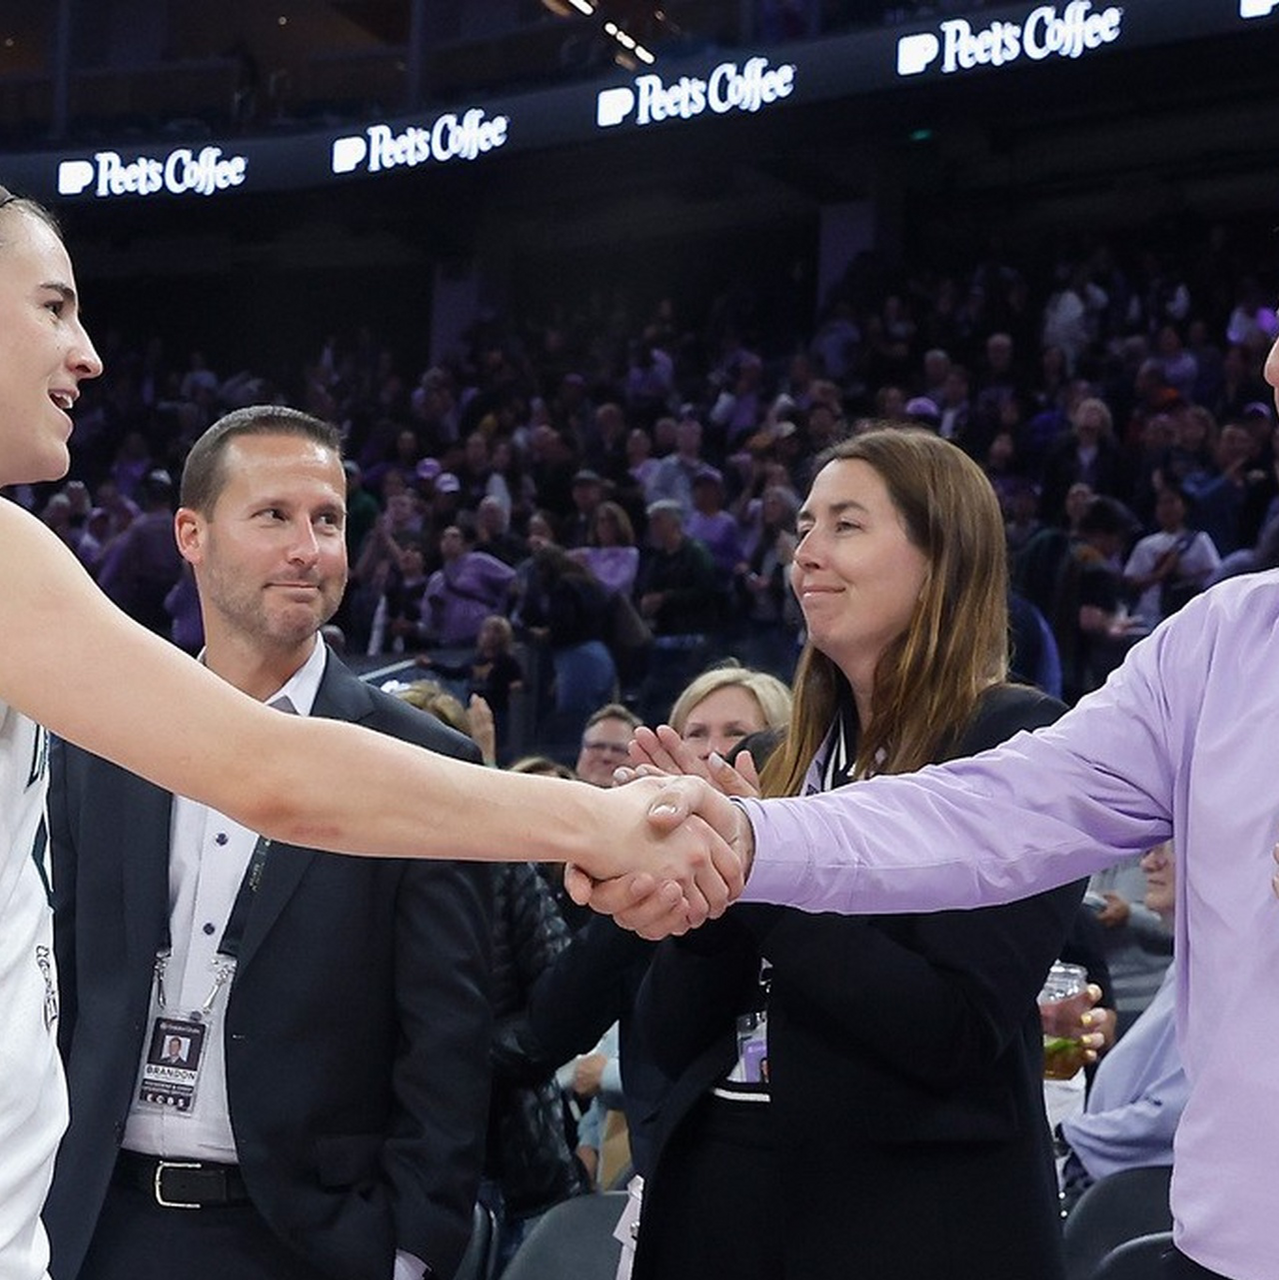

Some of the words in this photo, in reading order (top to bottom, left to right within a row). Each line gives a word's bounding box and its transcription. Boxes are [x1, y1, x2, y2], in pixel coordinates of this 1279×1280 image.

[940, 18, 1022, 73] Peet's
[1023, 0, 1121, 60] Coffee
[635, 72, 706, 125] Peet's
[708, 56, 796, 113] Coffee
[95, 151, 163, 197] Peet's
[165, 146, 246, 196] Coffee
[367, 124, 431, 172] Peet's
[431, 108, 508, 162] Coffee
[146, 1065, 197, 1081] BRANDON
